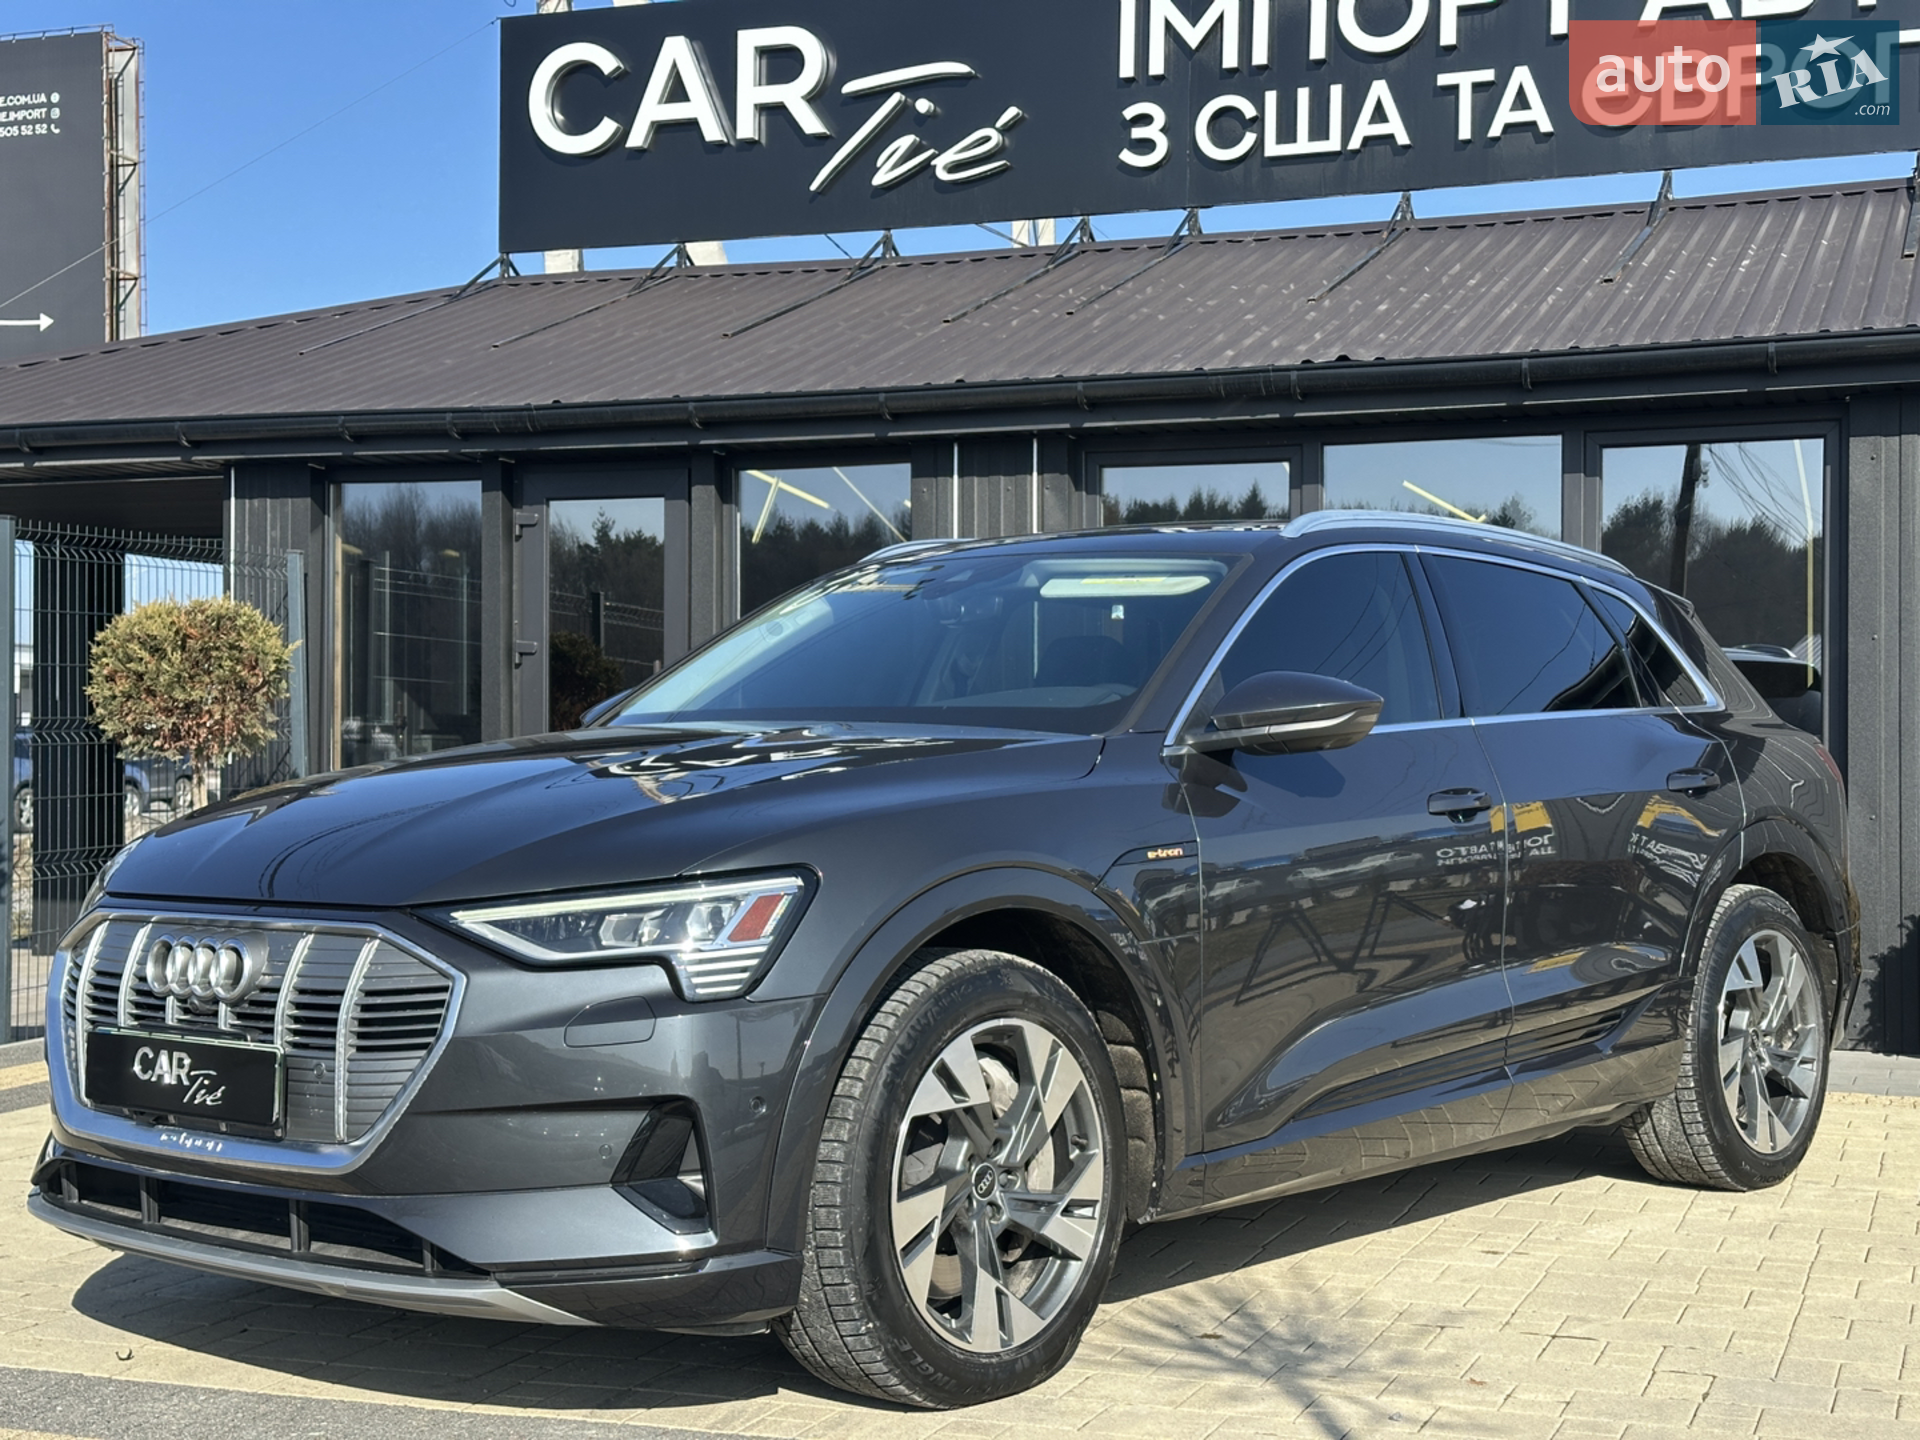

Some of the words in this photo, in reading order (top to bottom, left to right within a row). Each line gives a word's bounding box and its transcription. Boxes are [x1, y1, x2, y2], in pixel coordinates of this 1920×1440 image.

[528, 25, 831, 156] CAR
[1195, 79, 1412, 162] США
[1437, 65, 1555, 142] ТА
[20, 124, 34, 136] 52
[34, 123, 48, 134] 52
[133, 1046, 192, 1086] CAR
